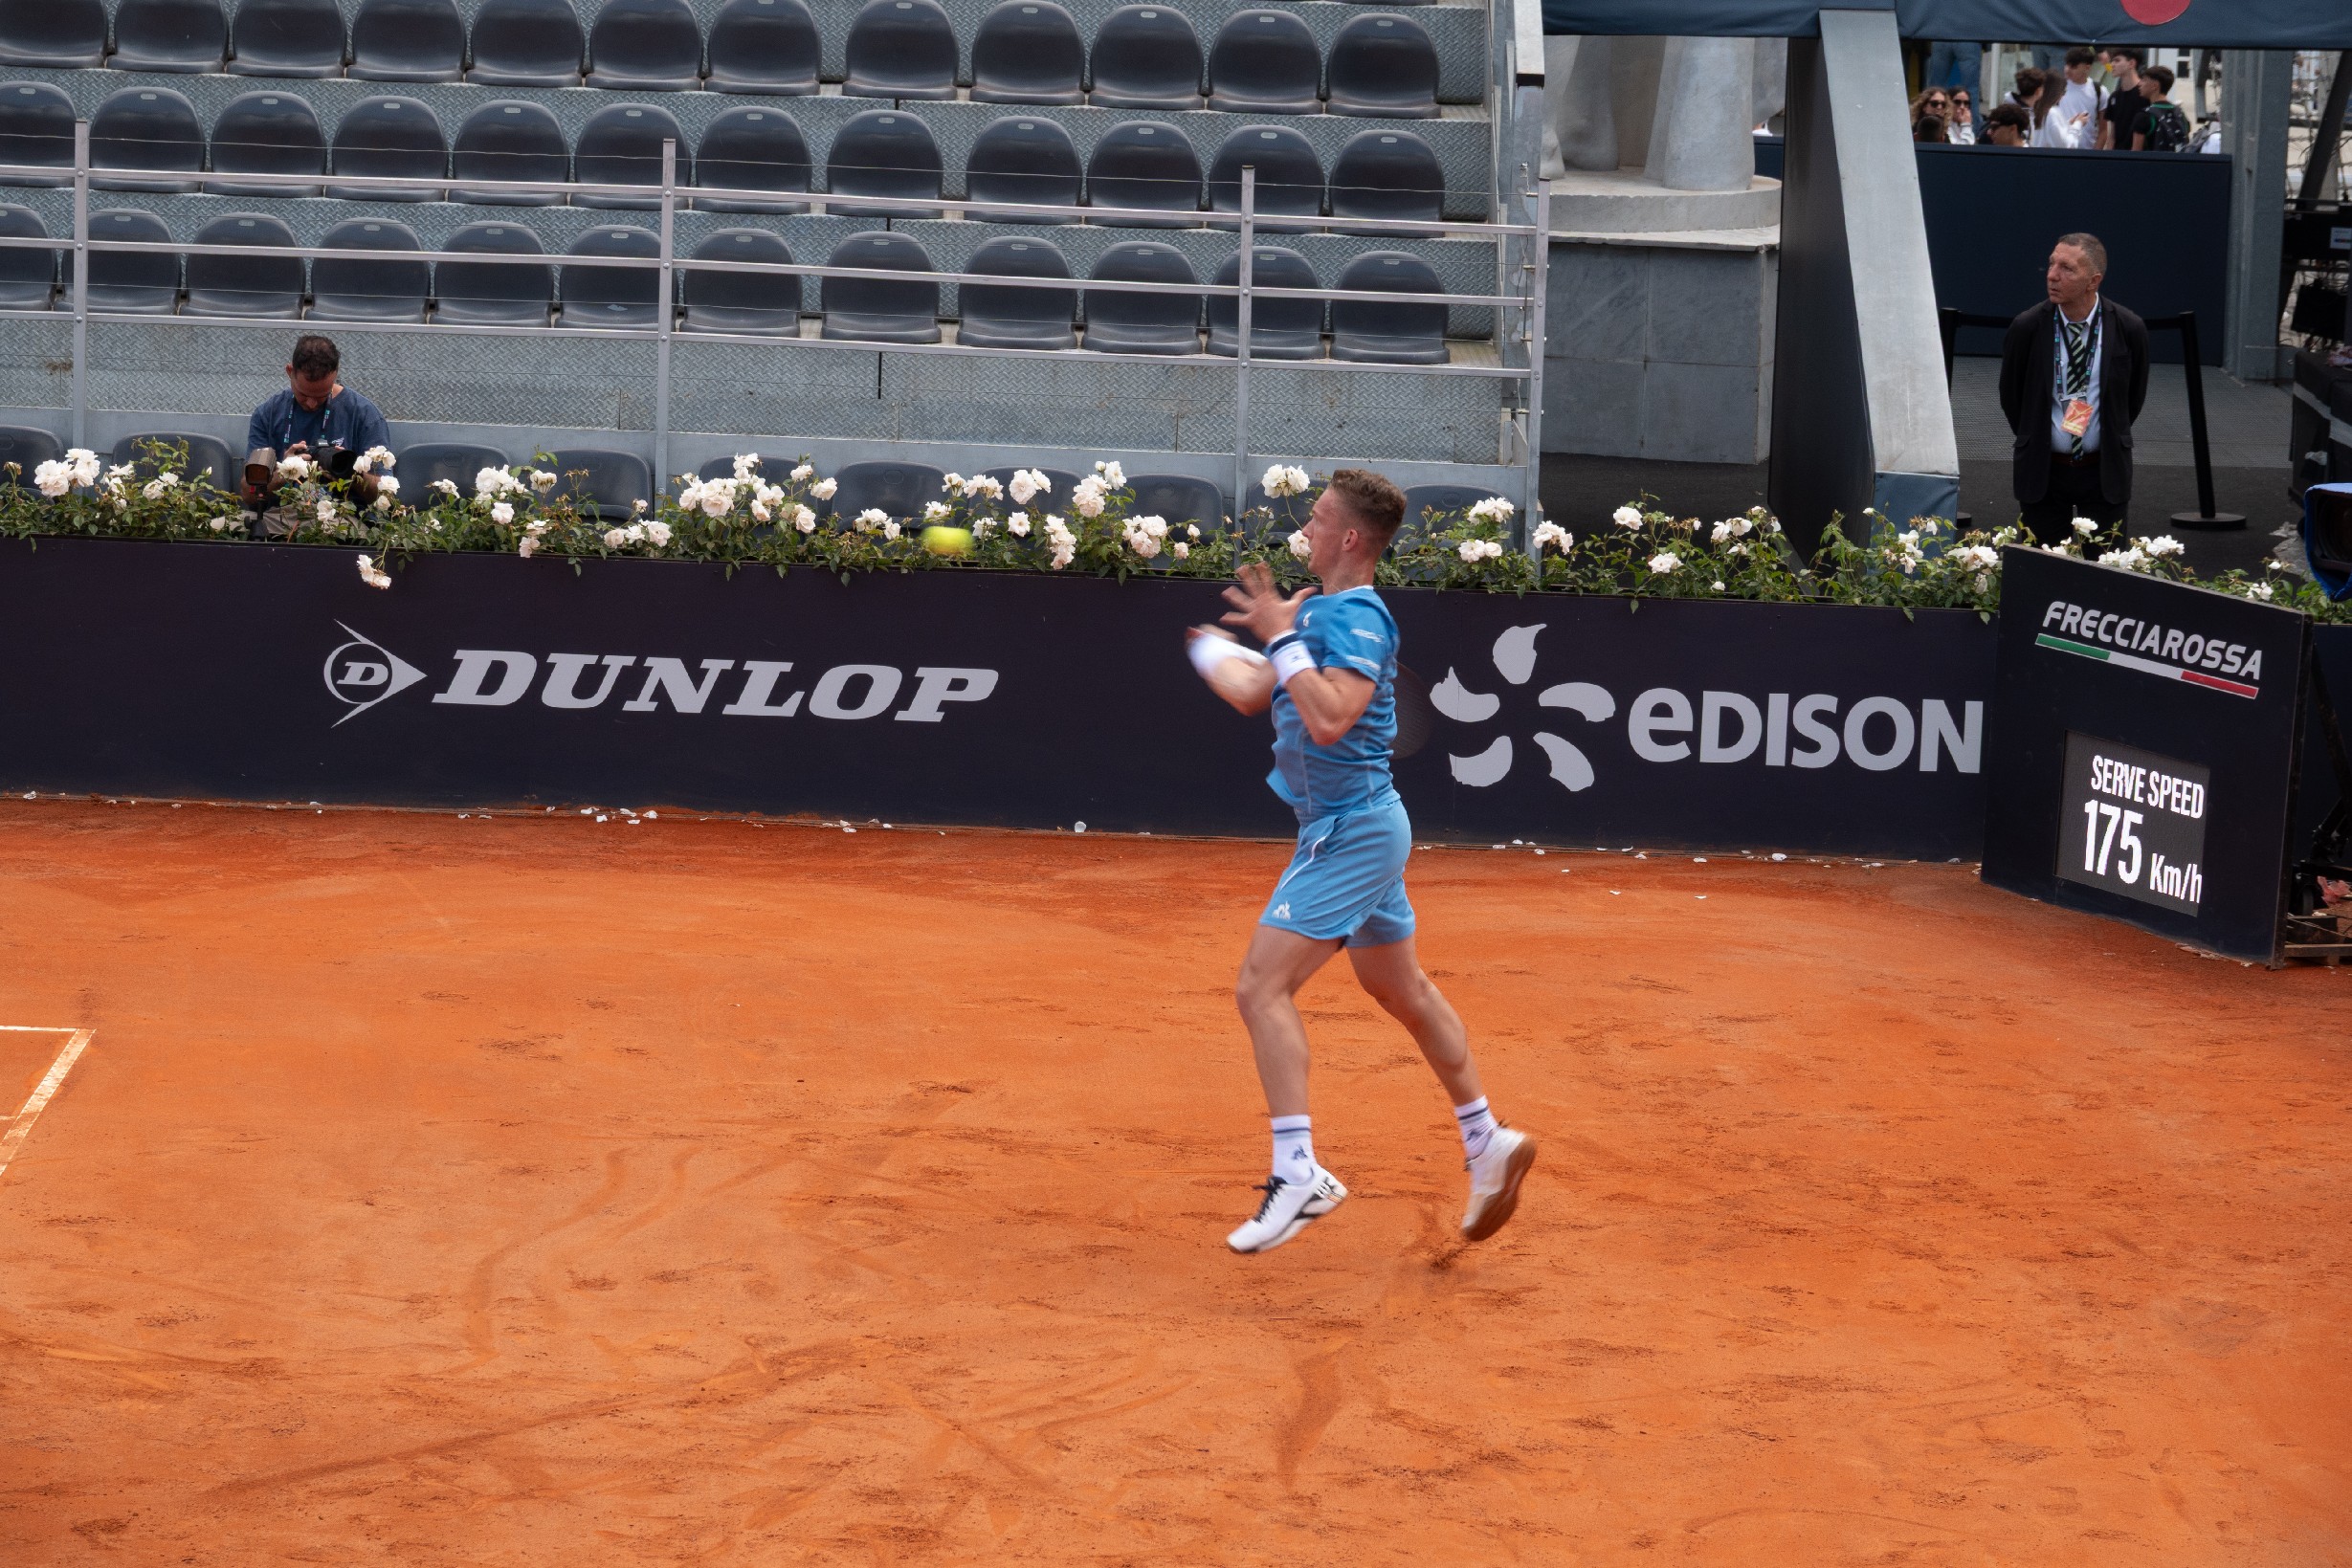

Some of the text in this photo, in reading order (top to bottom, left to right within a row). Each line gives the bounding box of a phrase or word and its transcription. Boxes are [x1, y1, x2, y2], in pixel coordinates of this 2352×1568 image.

[2043, 601, 2262, 680] FRECCIAROSSA
[337, 650, 999, 722] D DUNLOP
[2091, 754, 2205, 819] SERVE SPEED
[2084, 799, 2203, 904] 175 Km/h
